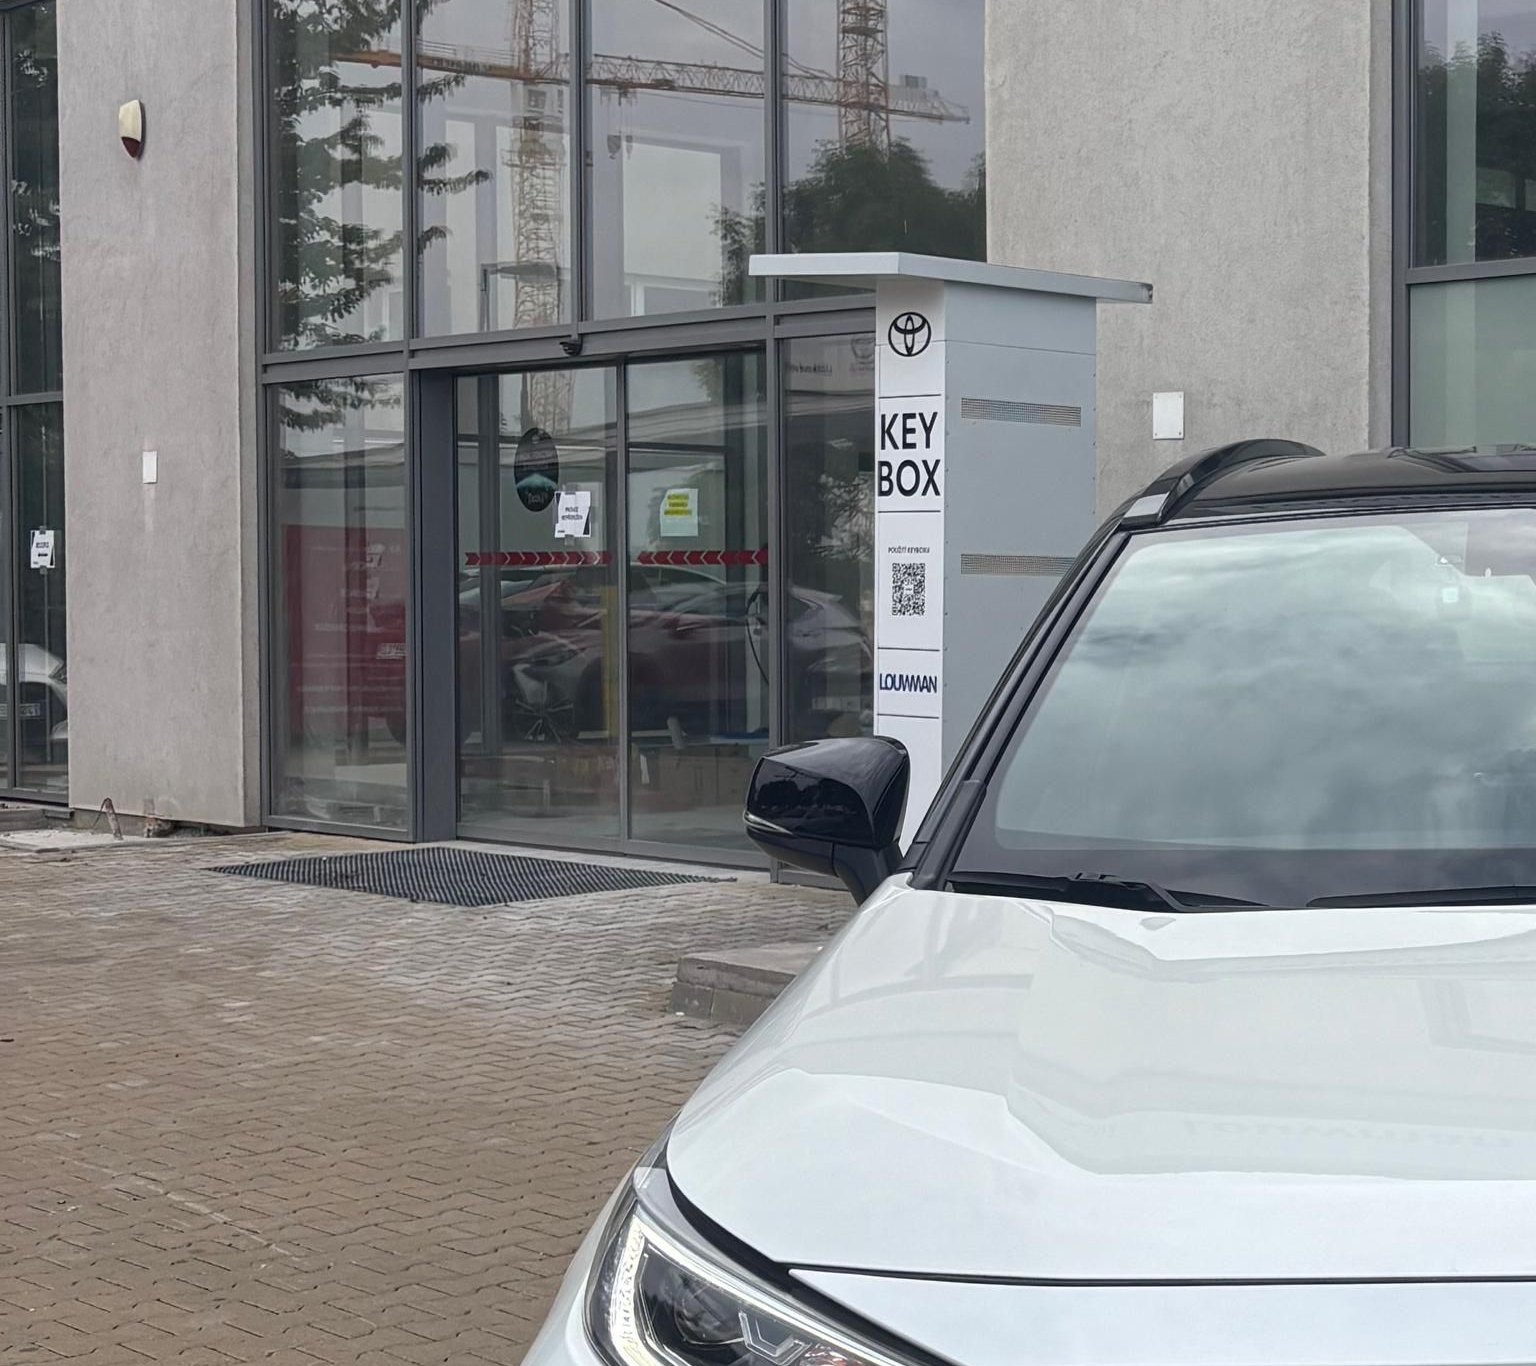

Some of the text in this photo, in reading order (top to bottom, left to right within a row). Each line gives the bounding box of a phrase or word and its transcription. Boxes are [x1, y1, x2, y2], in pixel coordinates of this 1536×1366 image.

[880, 412, 938, 450] KEY
[878, 459, 941, 497] BOX
[879, 673, 938, 694] LOUWMAN
